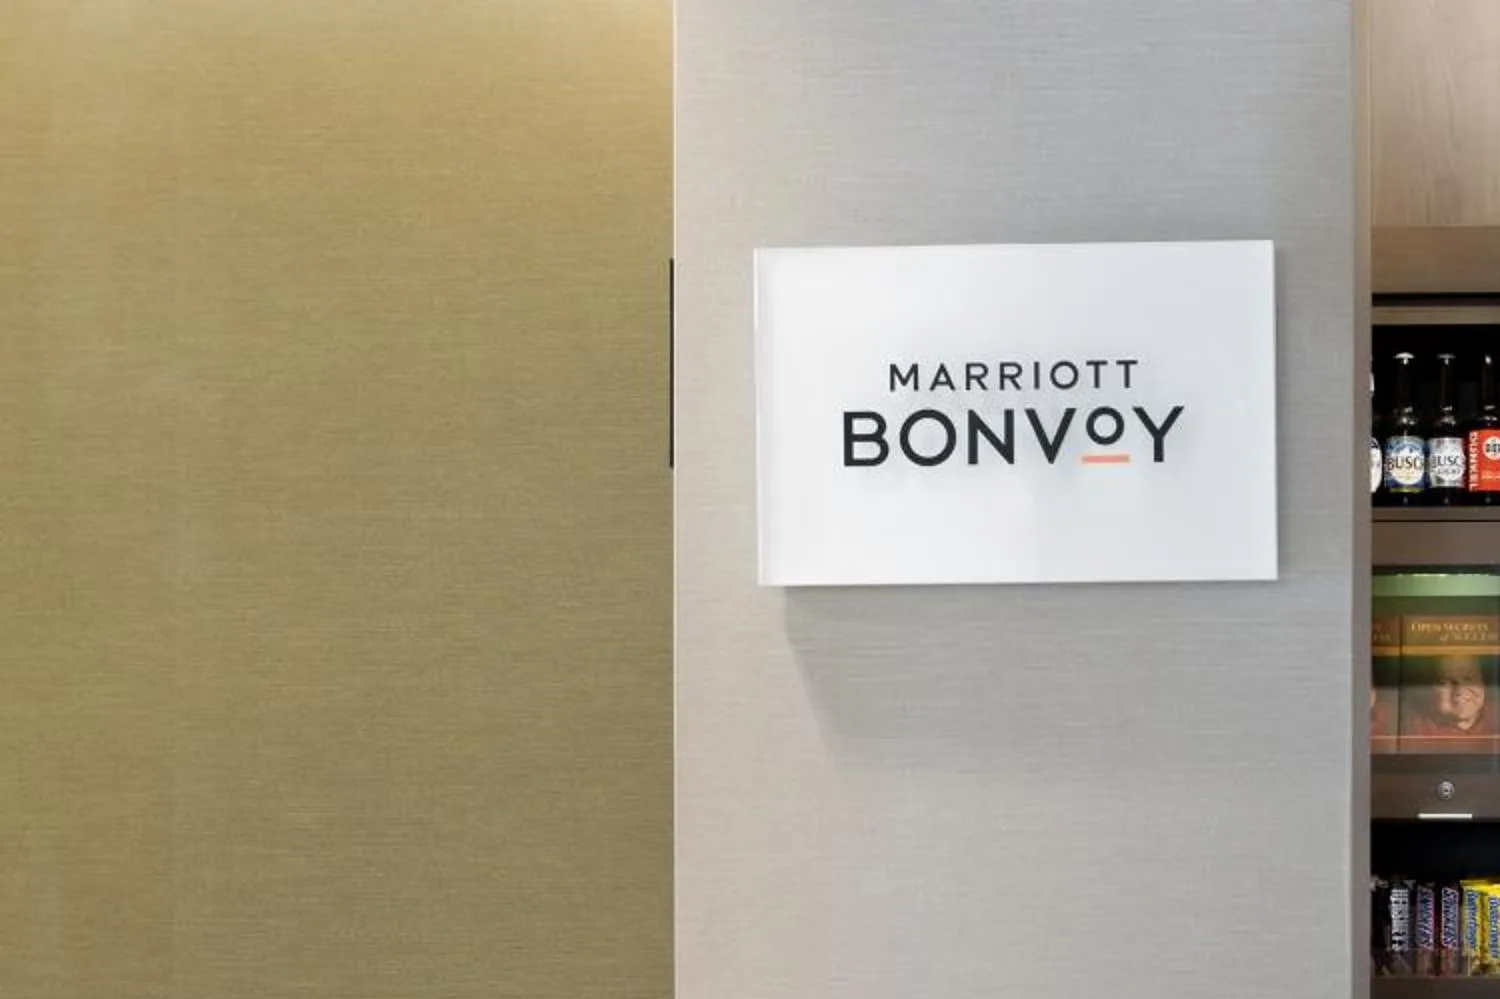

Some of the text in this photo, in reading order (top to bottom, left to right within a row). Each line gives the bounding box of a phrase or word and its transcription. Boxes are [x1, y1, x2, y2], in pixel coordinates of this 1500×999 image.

[889, 360, 1138, 391] MARRIOTT
[842, 405, 1185, 467] BONVOY
[1385, 455, 1424, 471] BUSC
